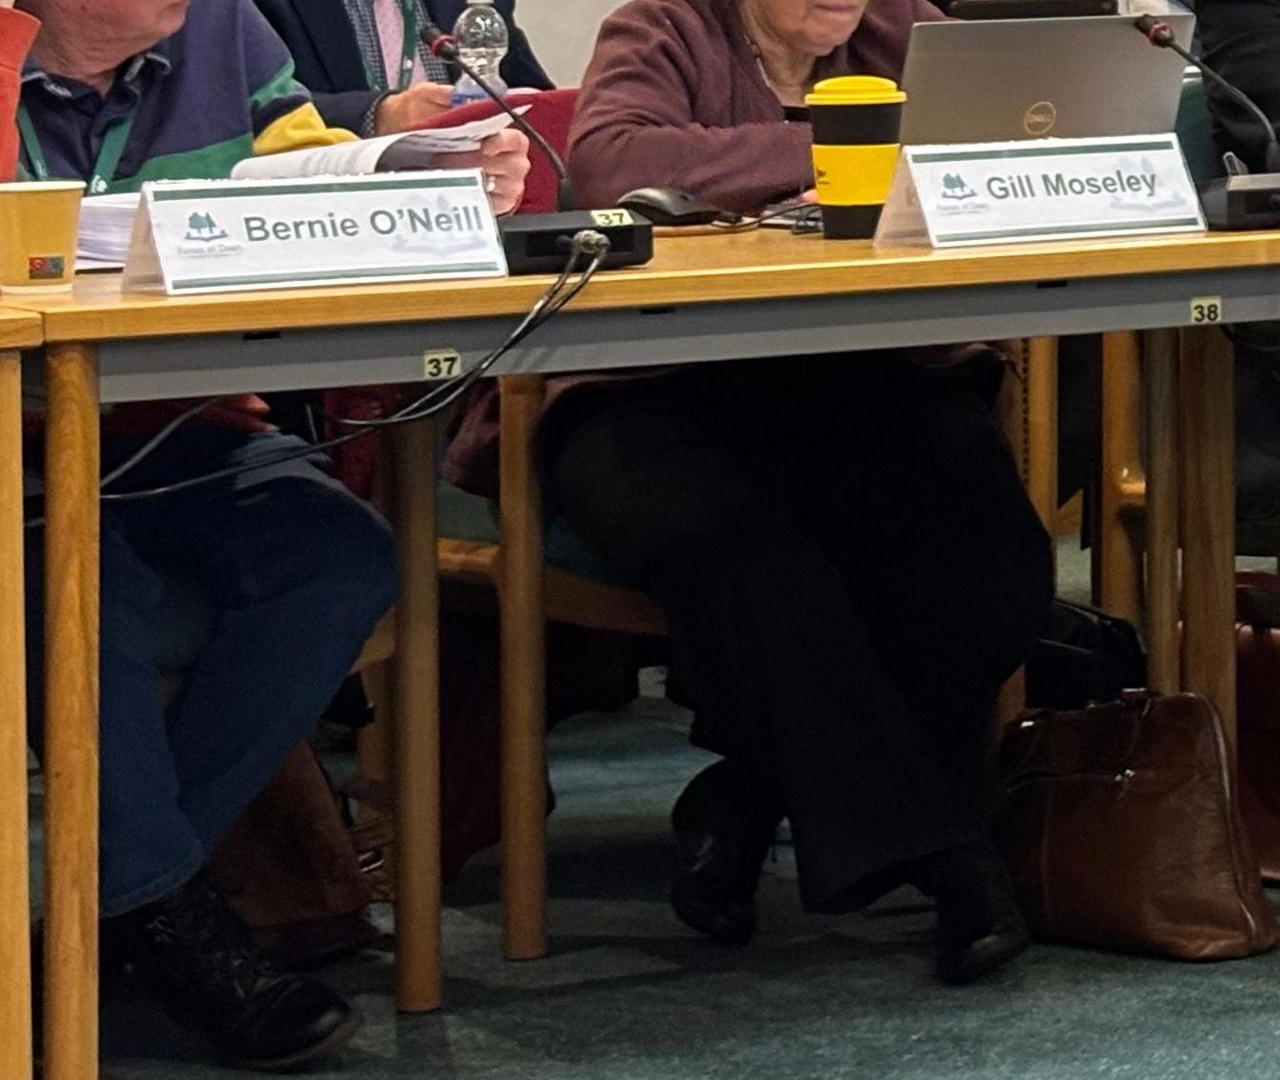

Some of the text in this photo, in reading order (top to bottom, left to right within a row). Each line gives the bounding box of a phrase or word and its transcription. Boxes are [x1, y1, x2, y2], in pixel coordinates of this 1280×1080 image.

[986, 170, 1157, 200] Gill Moseley
[243, 205, 485, 243] Bernie O'Neill
[598, 212, 626, 225] 37
[1193, 304, 1219, 322] 38
[427, 356, 458, 377] 37
